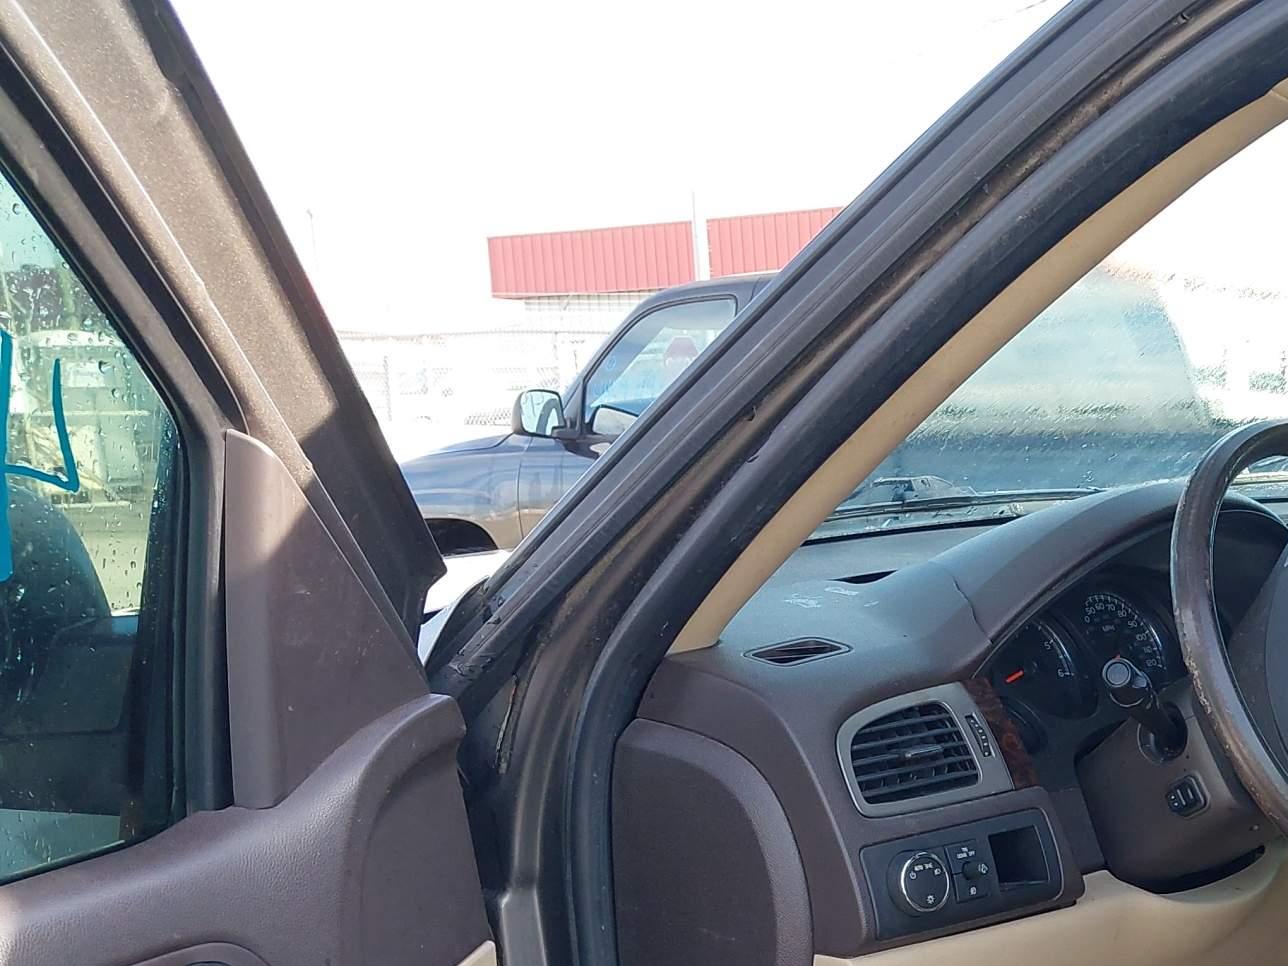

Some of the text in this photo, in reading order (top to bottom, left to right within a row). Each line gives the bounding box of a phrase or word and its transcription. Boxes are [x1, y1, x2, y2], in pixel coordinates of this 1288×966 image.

[1085, 606, 1096, 616] 50
[1044, 641, 1051, 650] 5
[1057, 668, 1065, 677] 6
